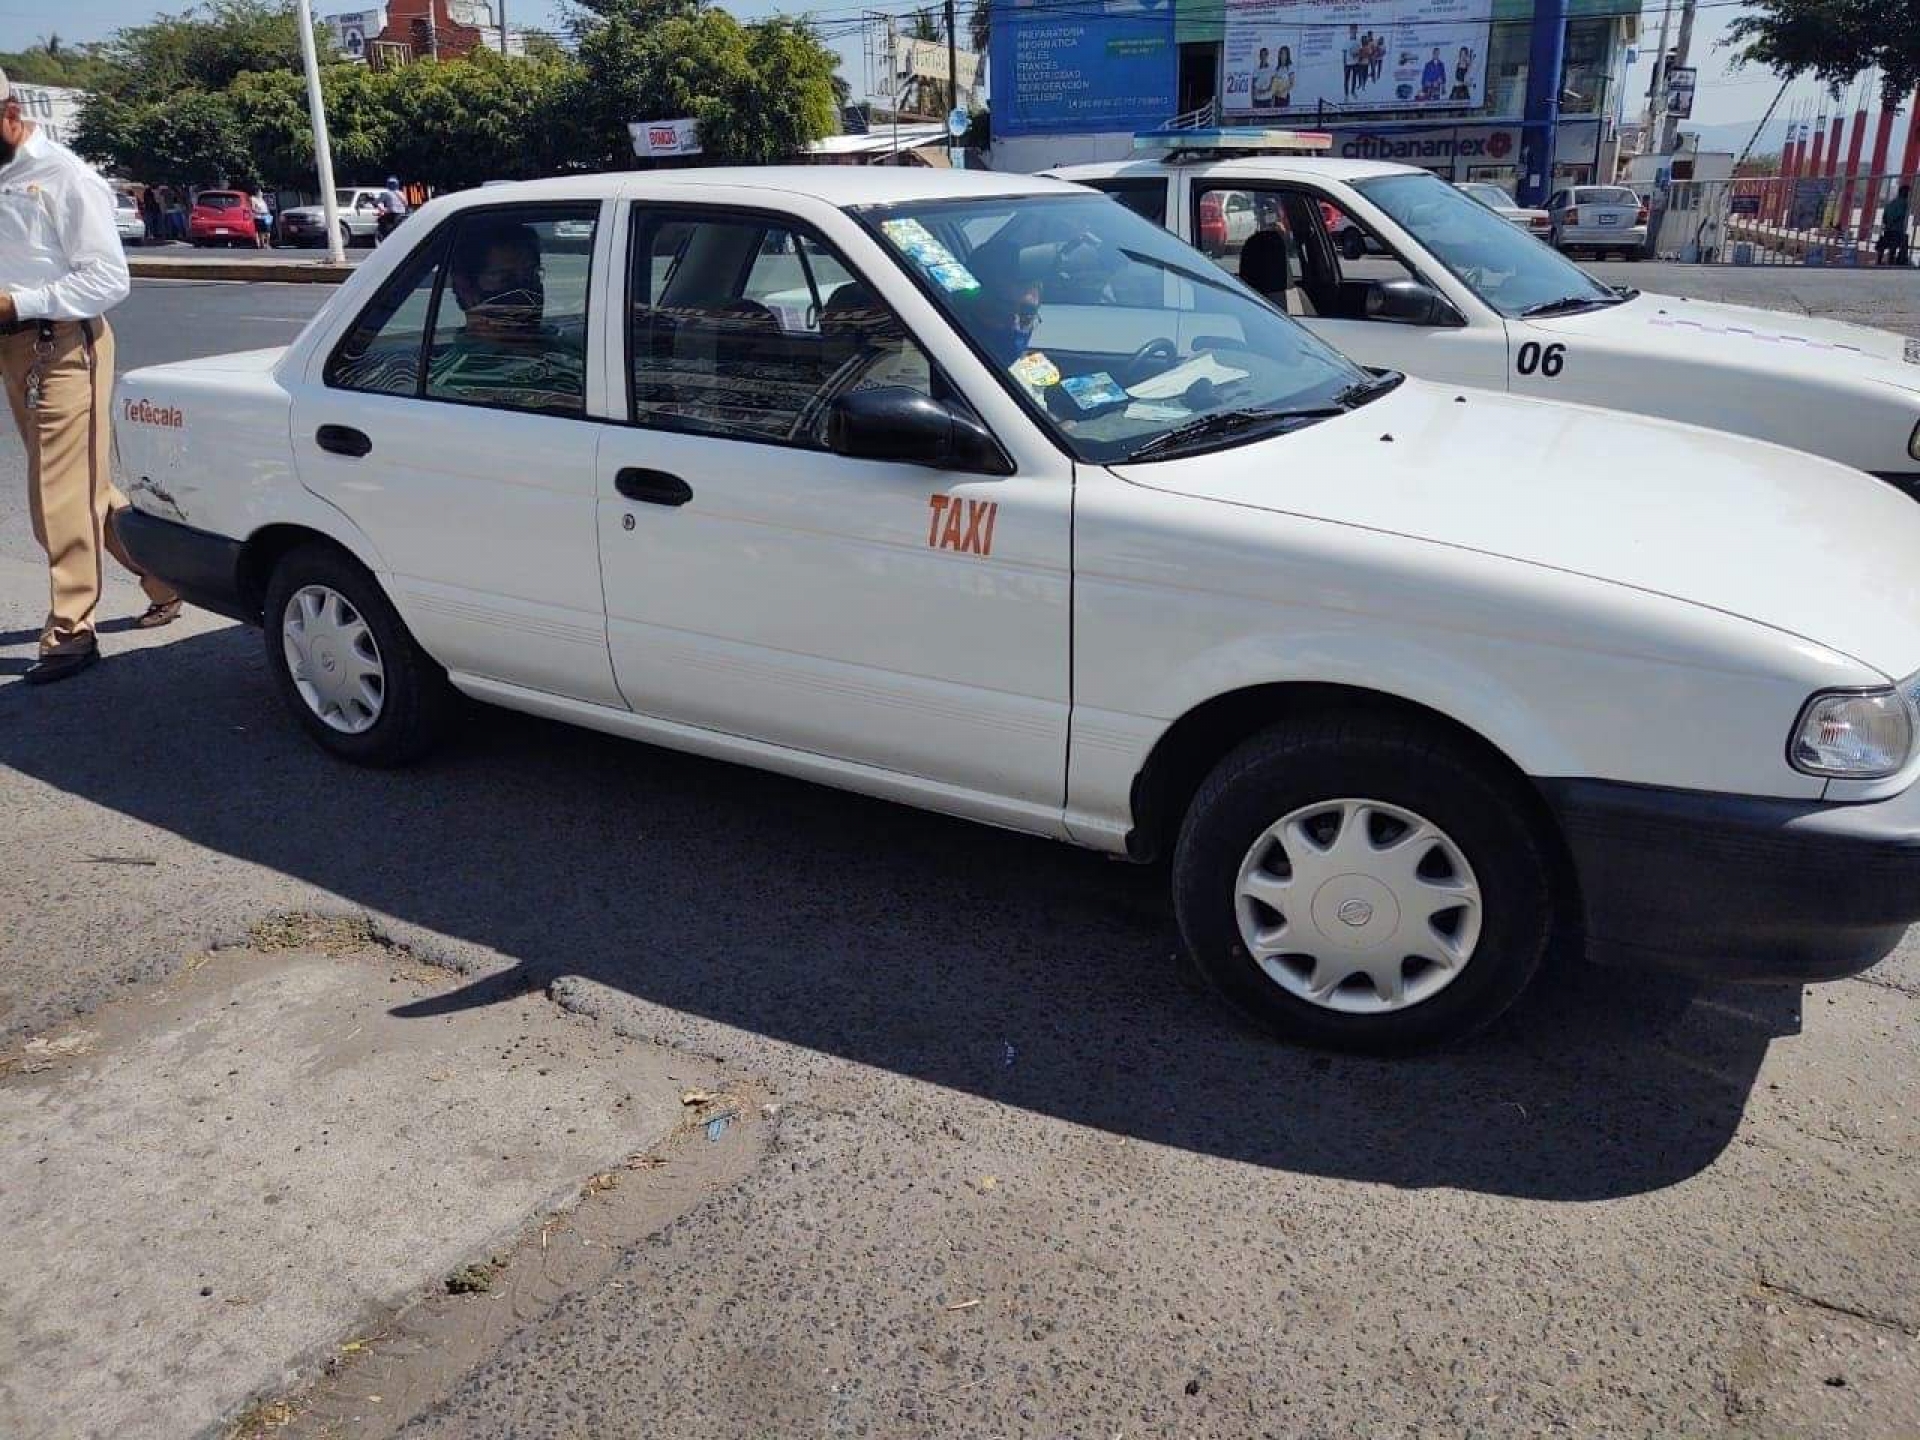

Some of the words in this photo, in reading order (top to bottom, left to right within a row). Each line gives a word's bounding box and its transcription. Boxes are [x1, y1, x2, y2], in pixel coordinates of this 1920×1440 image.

[1342, 134, 1486, 159] citibanamex
[1516, 341, 1567, 378] 06
[929, 494, 998, 556] TAXI
